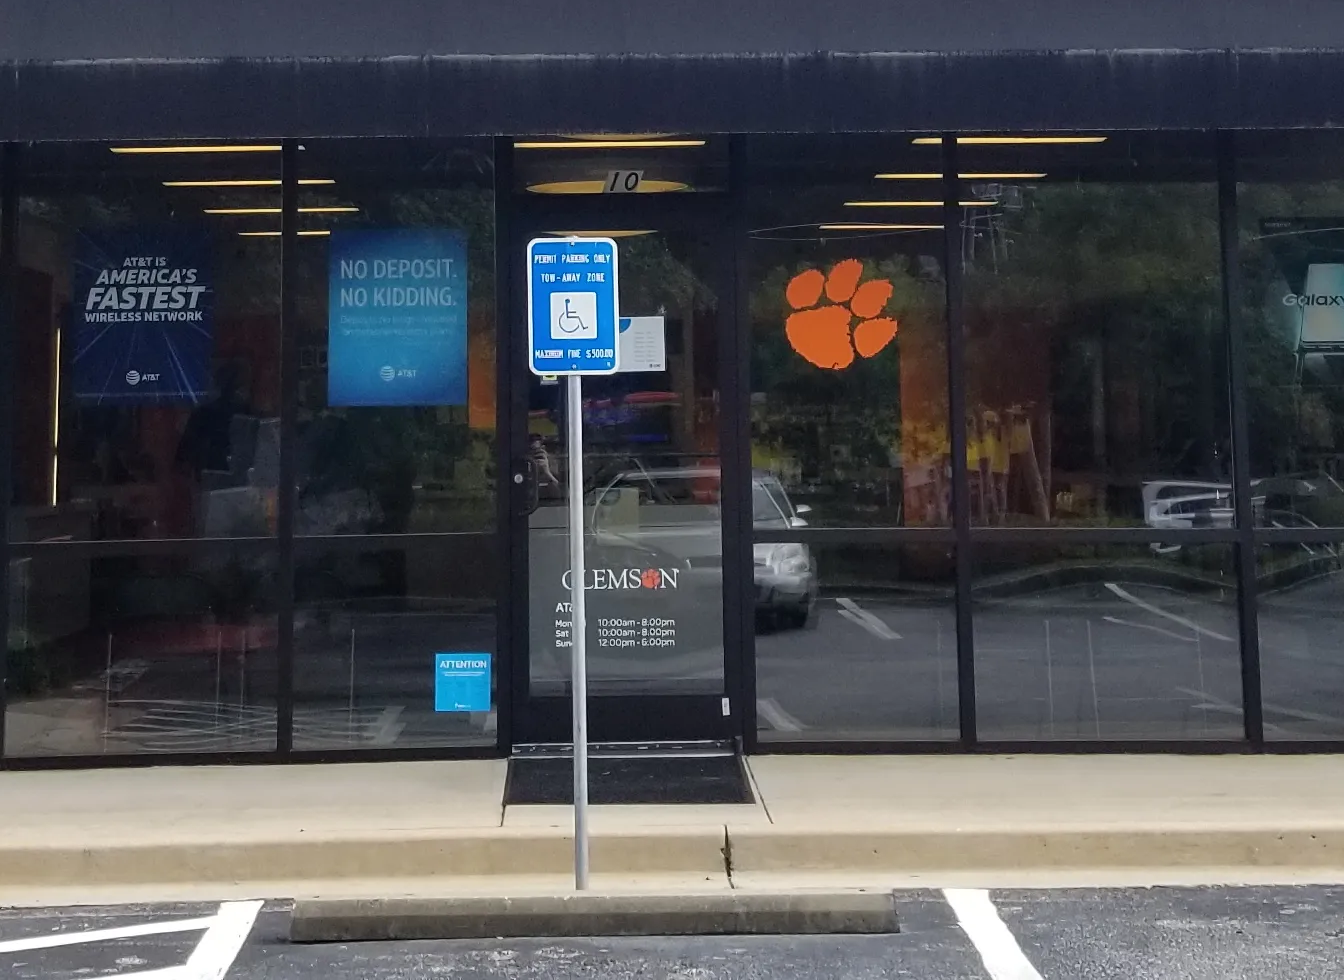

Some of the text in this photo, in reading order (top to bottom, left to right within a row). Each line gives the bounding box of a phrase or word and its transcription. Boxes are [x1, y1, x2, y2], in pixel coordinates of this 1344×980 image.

[608, 171, 639, 192] 10
[122, 256, 167, 267] AT&T IS
[534, 253, 611, 264] PERMIT PARKING ONLY
[340, 258, 458, 279] NO DEPOSIT.
[96, 268, 198, 285] AMERICA'S
[586, 272, 605, 283] ZONE
[85, 285, 207, 310] FASTEST
[340, 286, 458, 307] NO KIDDING.
[84, 311, 203, 323] WIRELESS NETWORK
[567, 348, 581, 359] FINE
[142, 373, 161, 381] AT&T
[397, 369, 417, 379] AT&T
[598, 618, 635, 627] 10:00am
[555, 629, 570, 638] Sat
[598, 628, 635, 637] 10:00am
[598, 638, 635, 649] 12:00pm
[642, 638, 676, 648] 6:00pm
[439, 660, 487, 669] ATTENTION
